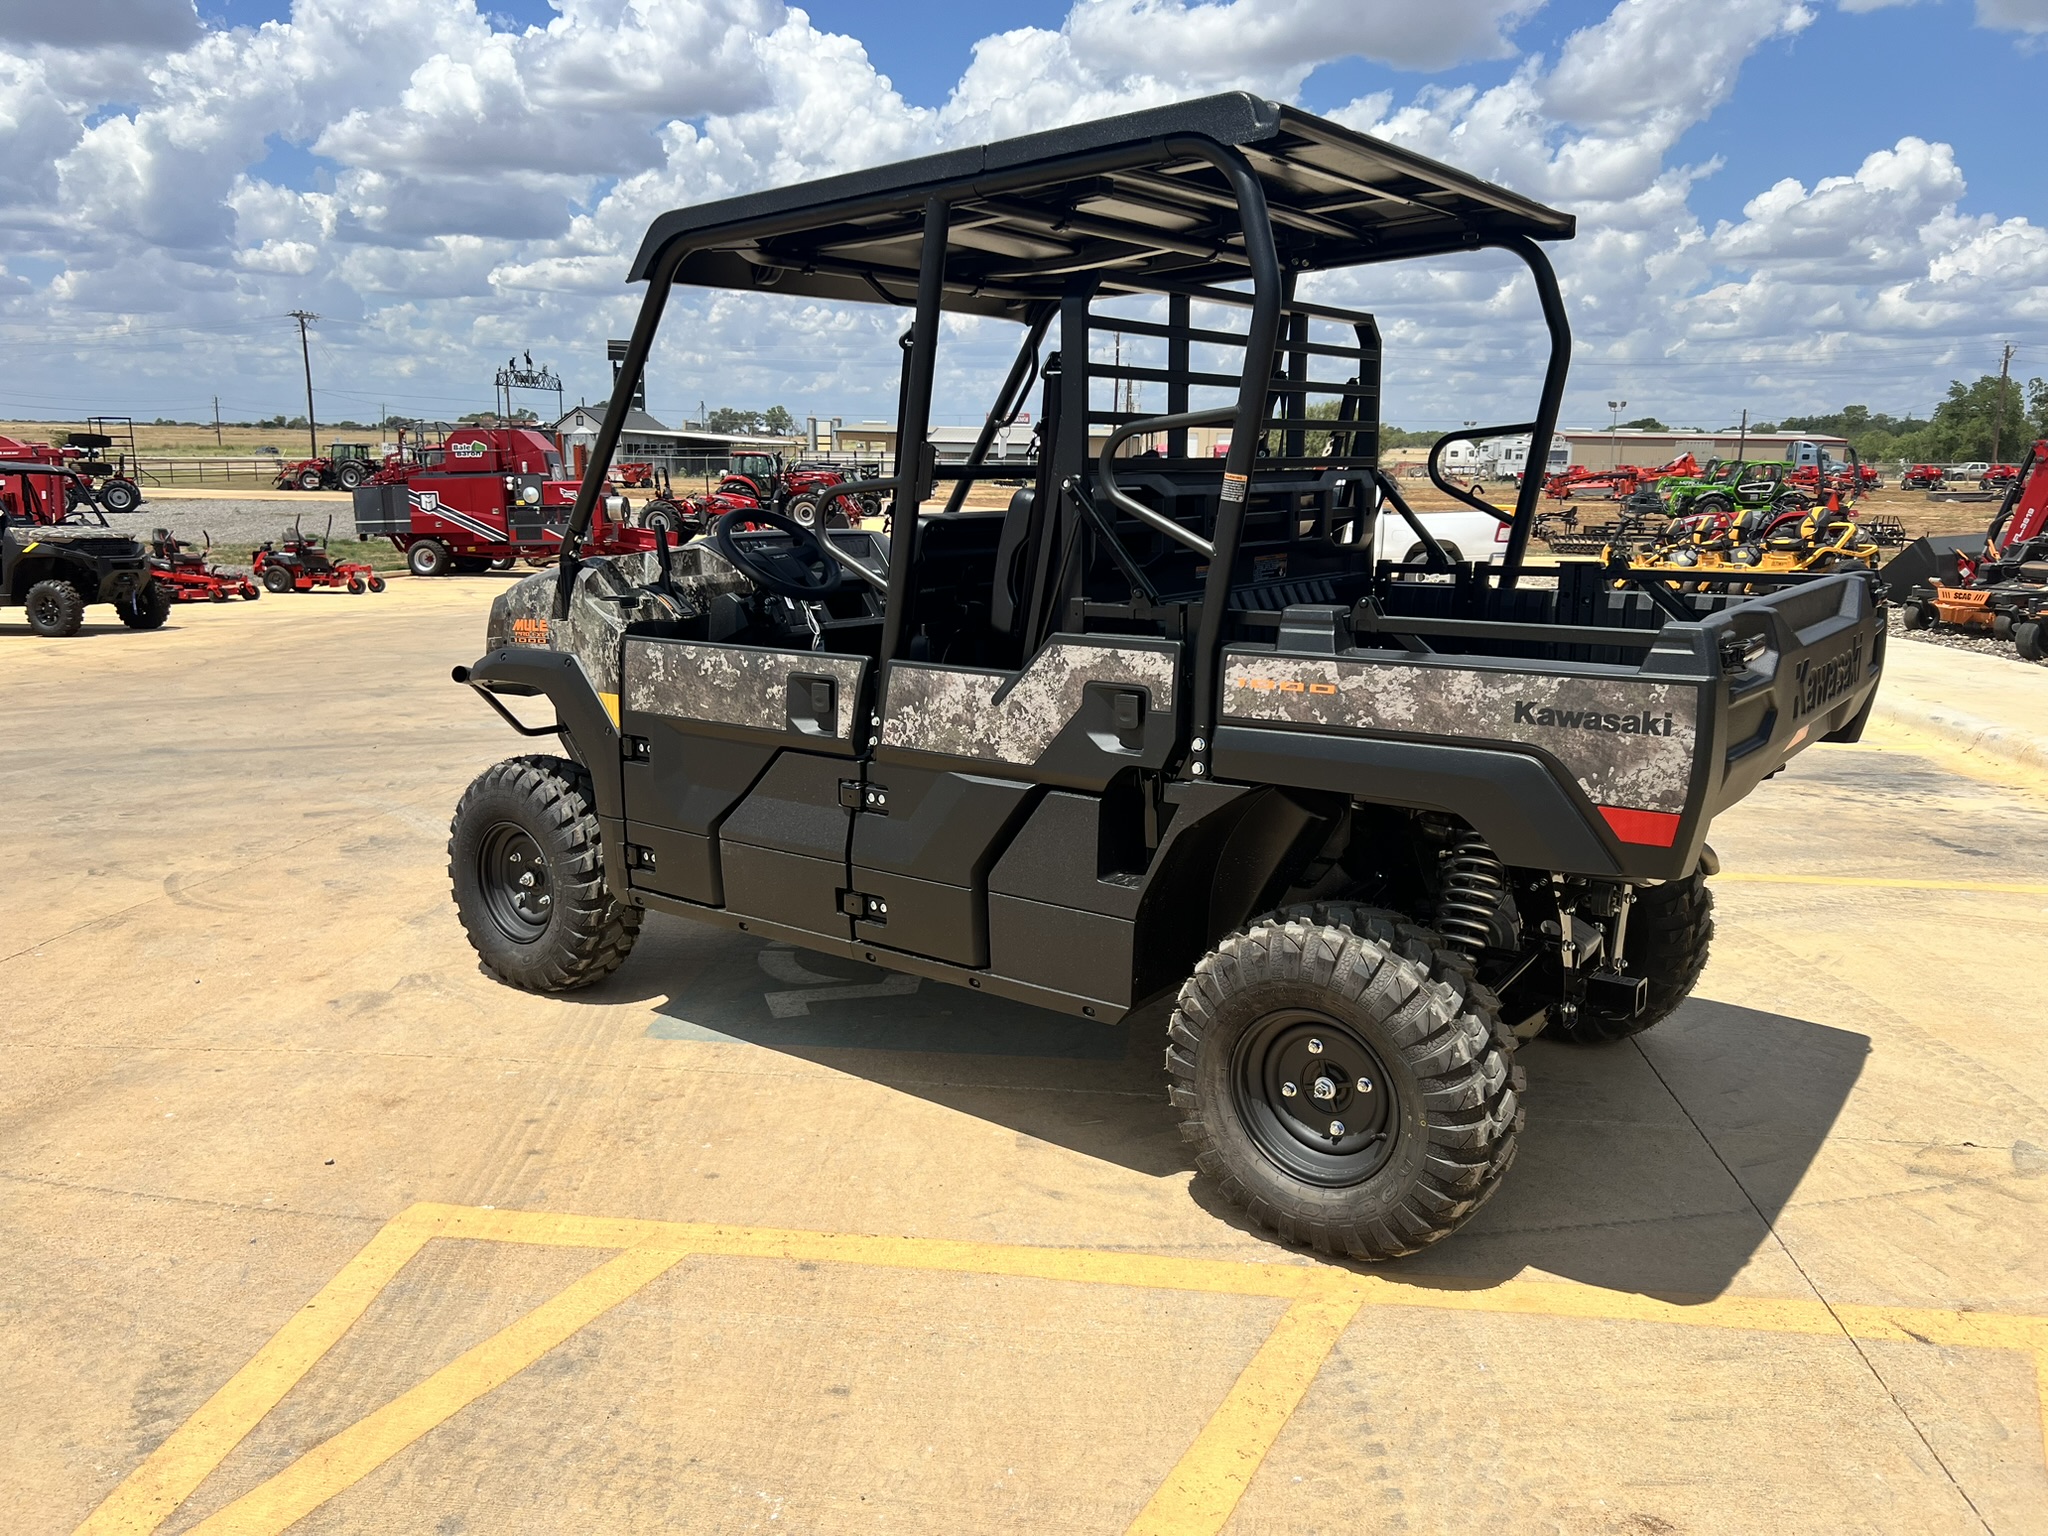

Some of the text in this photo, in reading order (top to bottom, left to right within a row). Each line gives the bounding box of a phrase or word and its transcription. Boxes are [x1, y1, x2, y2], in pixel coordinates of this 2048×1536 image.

[512, 618, 549, 631] MULE
[1793, 631, 1864, 720] Kawasaki
[1513, 700, 1673, 737] Kawasaki
